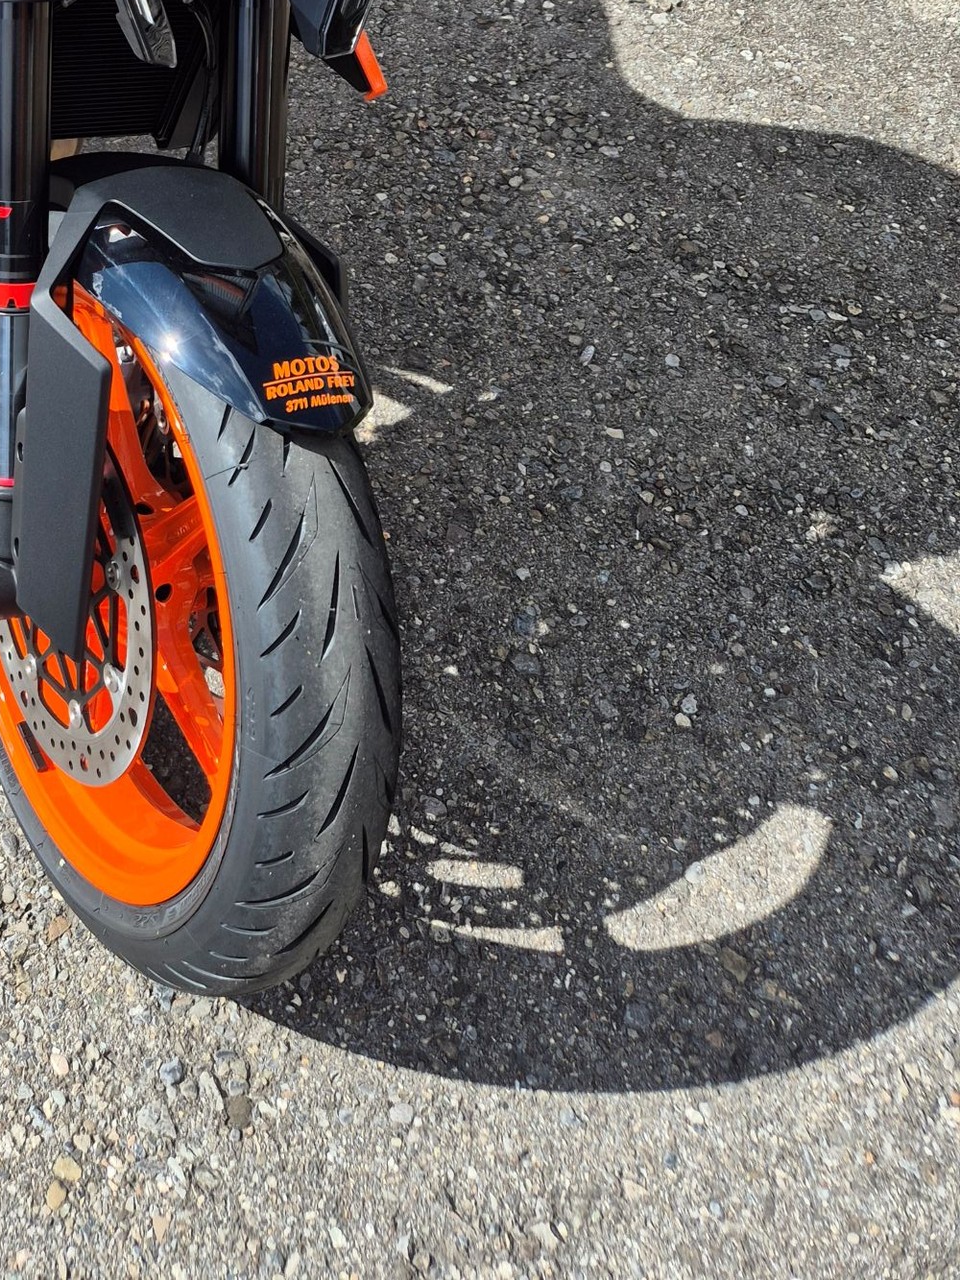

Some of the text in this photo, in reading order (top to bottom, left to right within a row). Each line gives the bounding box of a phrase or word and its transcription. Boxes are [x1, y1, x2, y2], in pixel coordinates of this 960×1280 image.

[273, 355, 340, 380] MOTOS
[266, 375, 355, 400] ROLAND FREY
[286, 397, 308, 413] 3711
